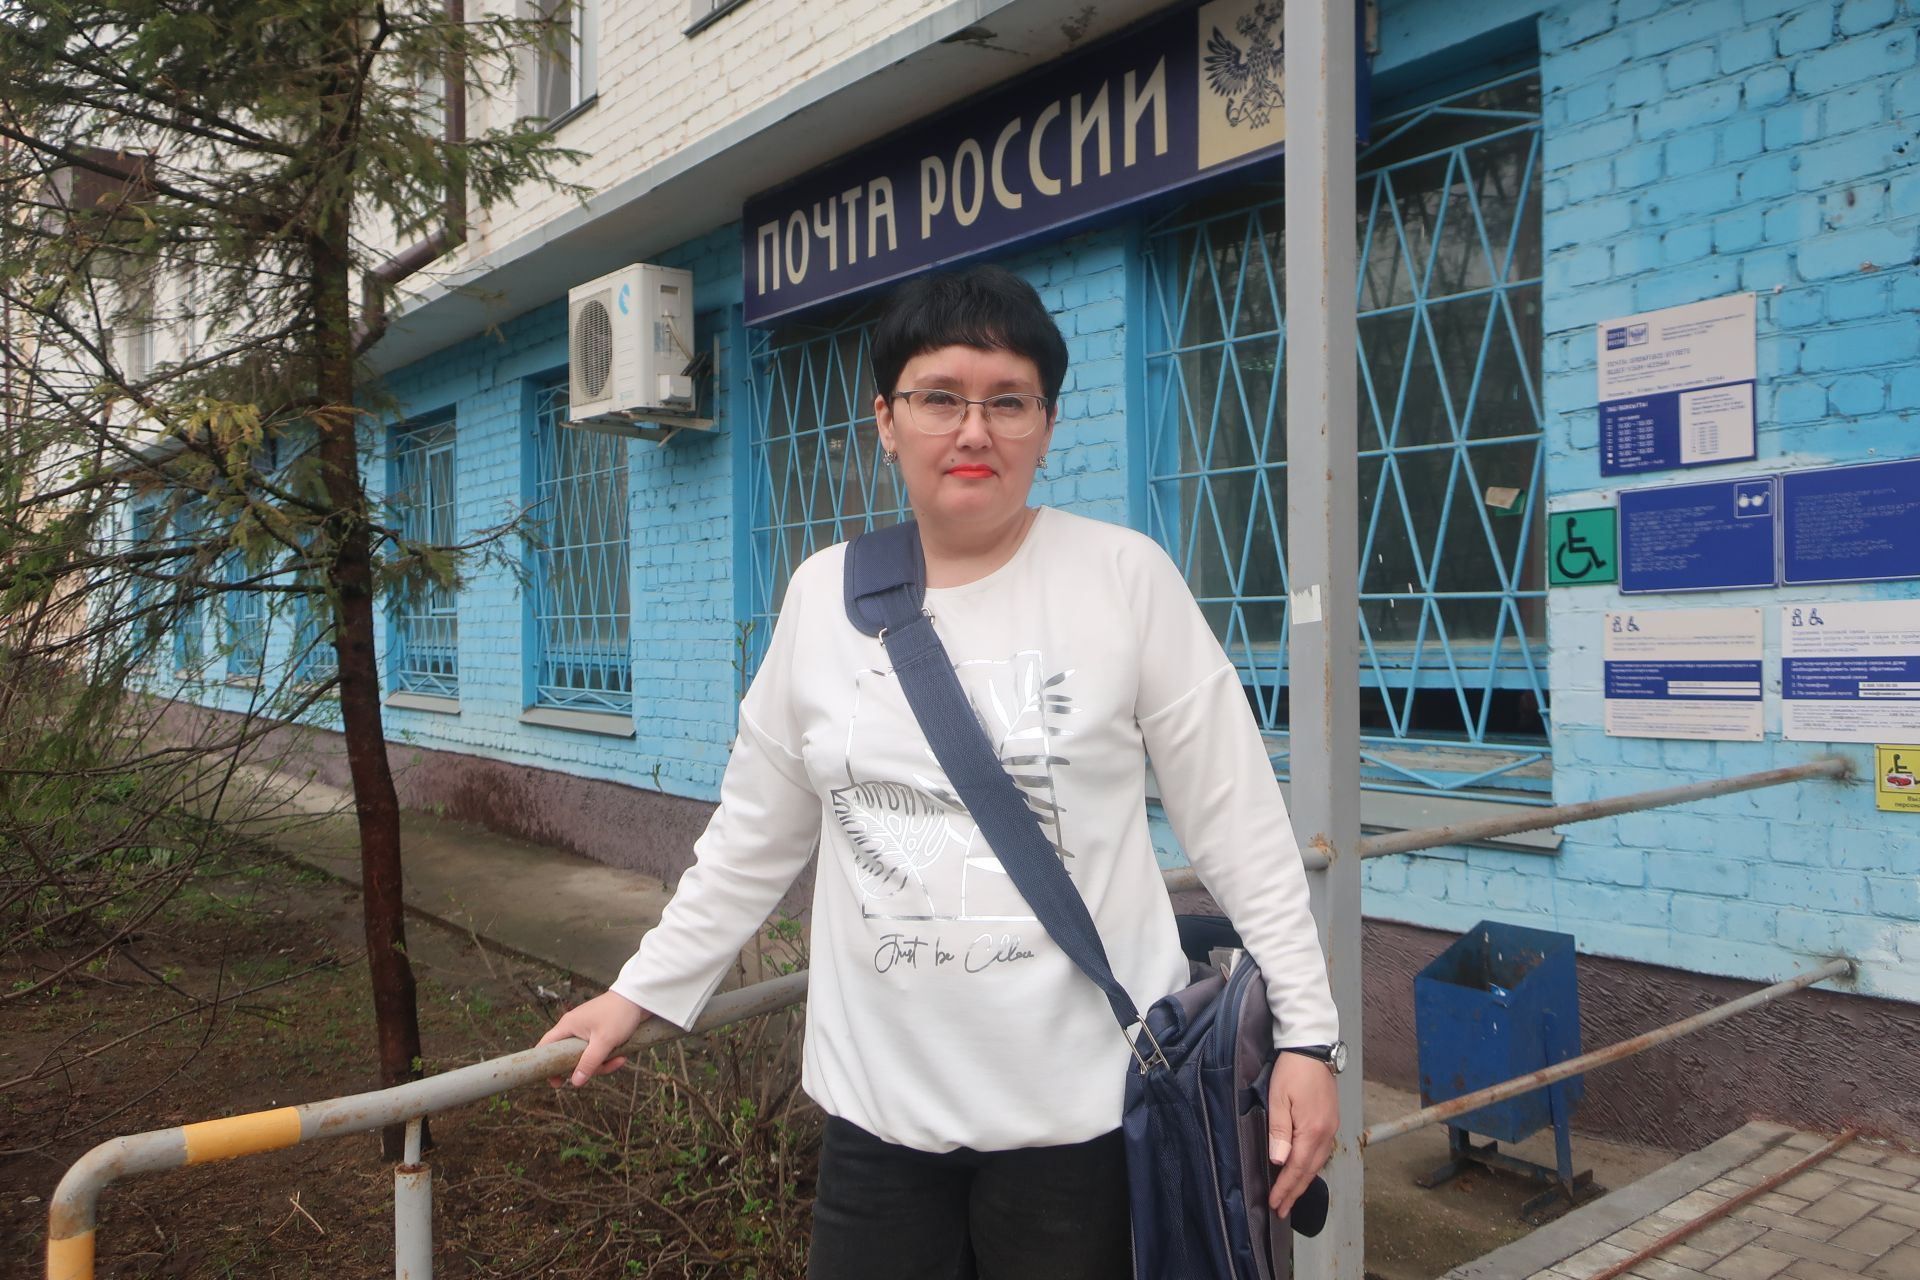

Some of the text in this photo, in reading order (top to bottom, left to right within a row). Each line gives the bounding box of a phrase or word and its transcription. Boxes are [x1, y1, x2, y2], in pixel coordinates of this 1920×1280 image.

[758, 53, 1169, 296] ПОЧТА РОССИИ
[875, 933, 929, 974] Just
[936, 936, 955, 967] be
